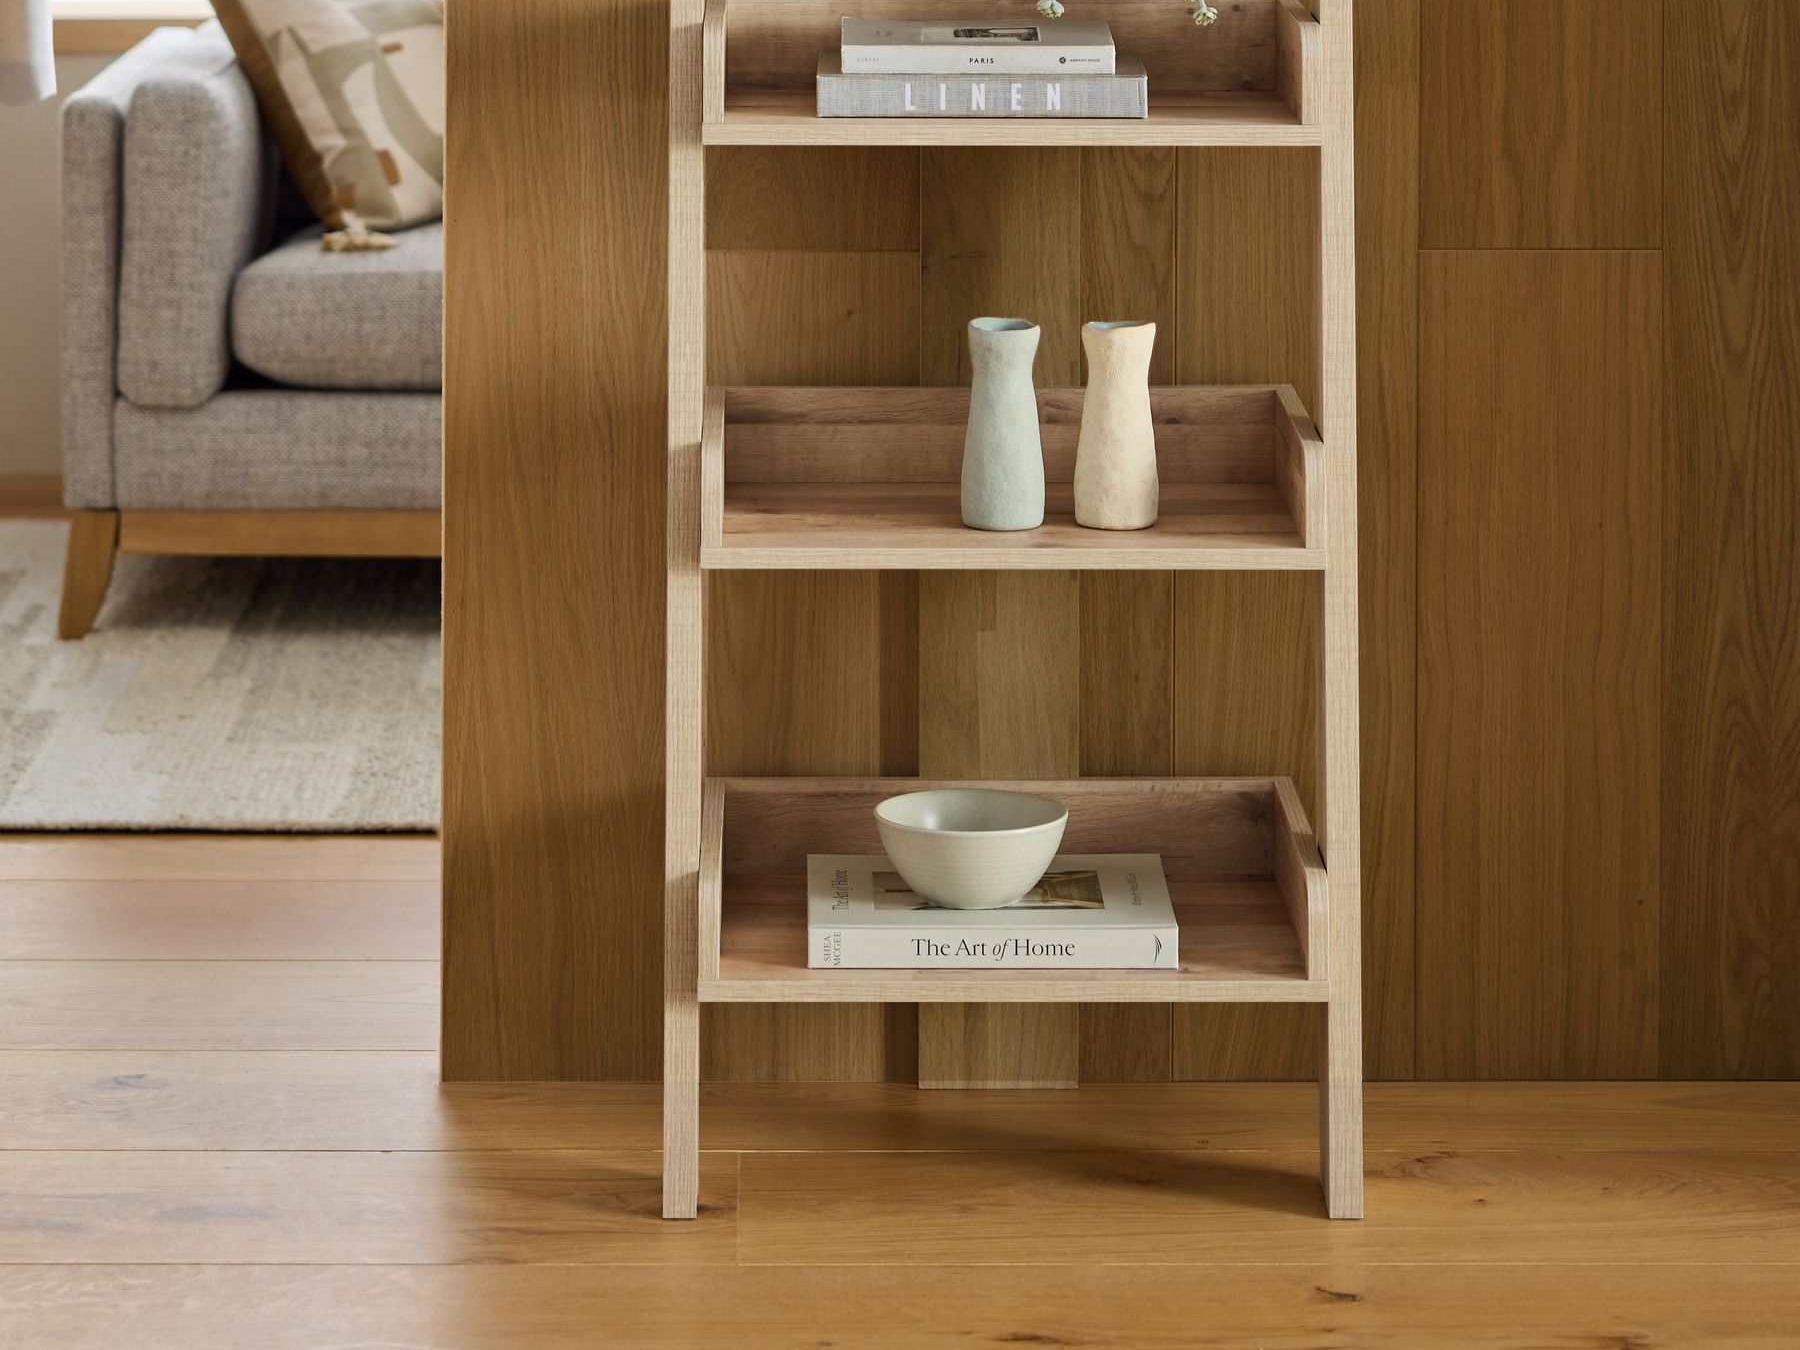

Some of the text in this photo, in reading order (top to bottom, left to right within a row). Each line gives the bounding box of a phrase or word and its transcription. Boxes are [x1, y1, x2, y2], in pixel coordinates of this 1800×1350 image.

[904, 83, 1061, 111] LINEN
[823, 935, 831, 962] SHEA
[911, 938, 1076, 961] The Art of Home
